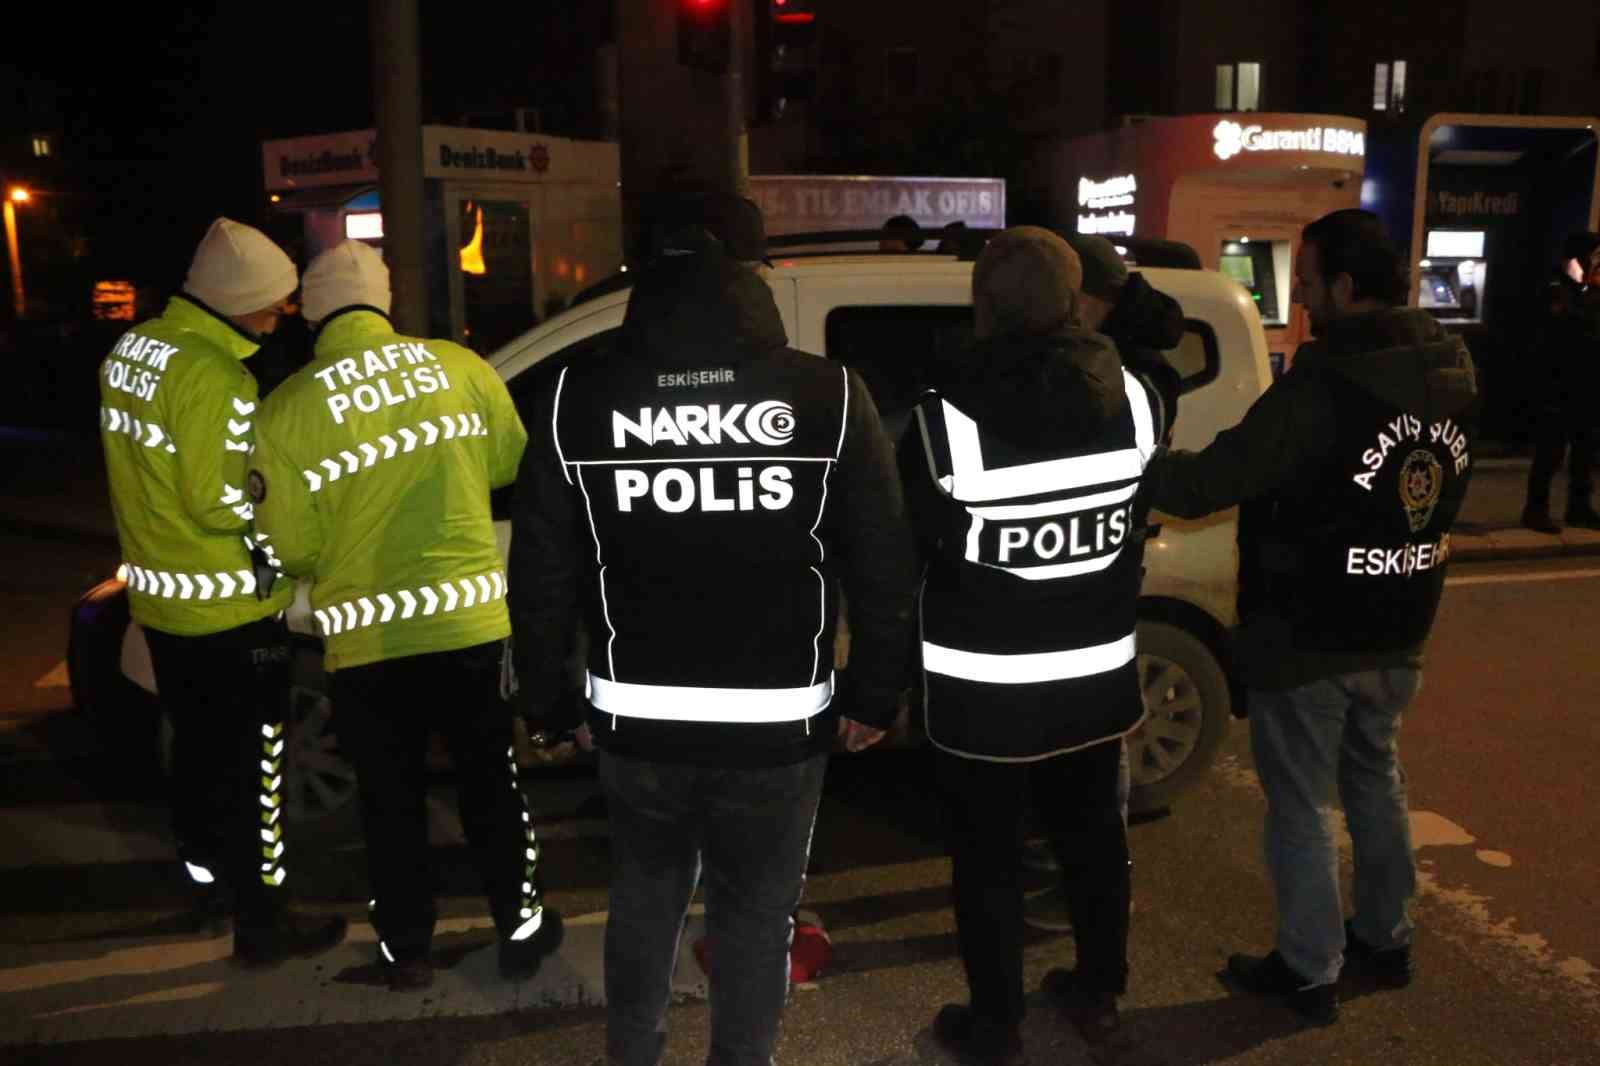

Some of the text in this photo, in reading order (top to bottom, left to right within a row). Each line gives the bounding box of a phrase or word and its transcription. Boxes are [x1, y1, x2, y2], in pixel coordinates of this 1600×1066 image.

[1241, 125, 1321, 151] Garanti
[440, 144, 526, 171] DenizBank
[843, 187, 932, 216] EMLAK
